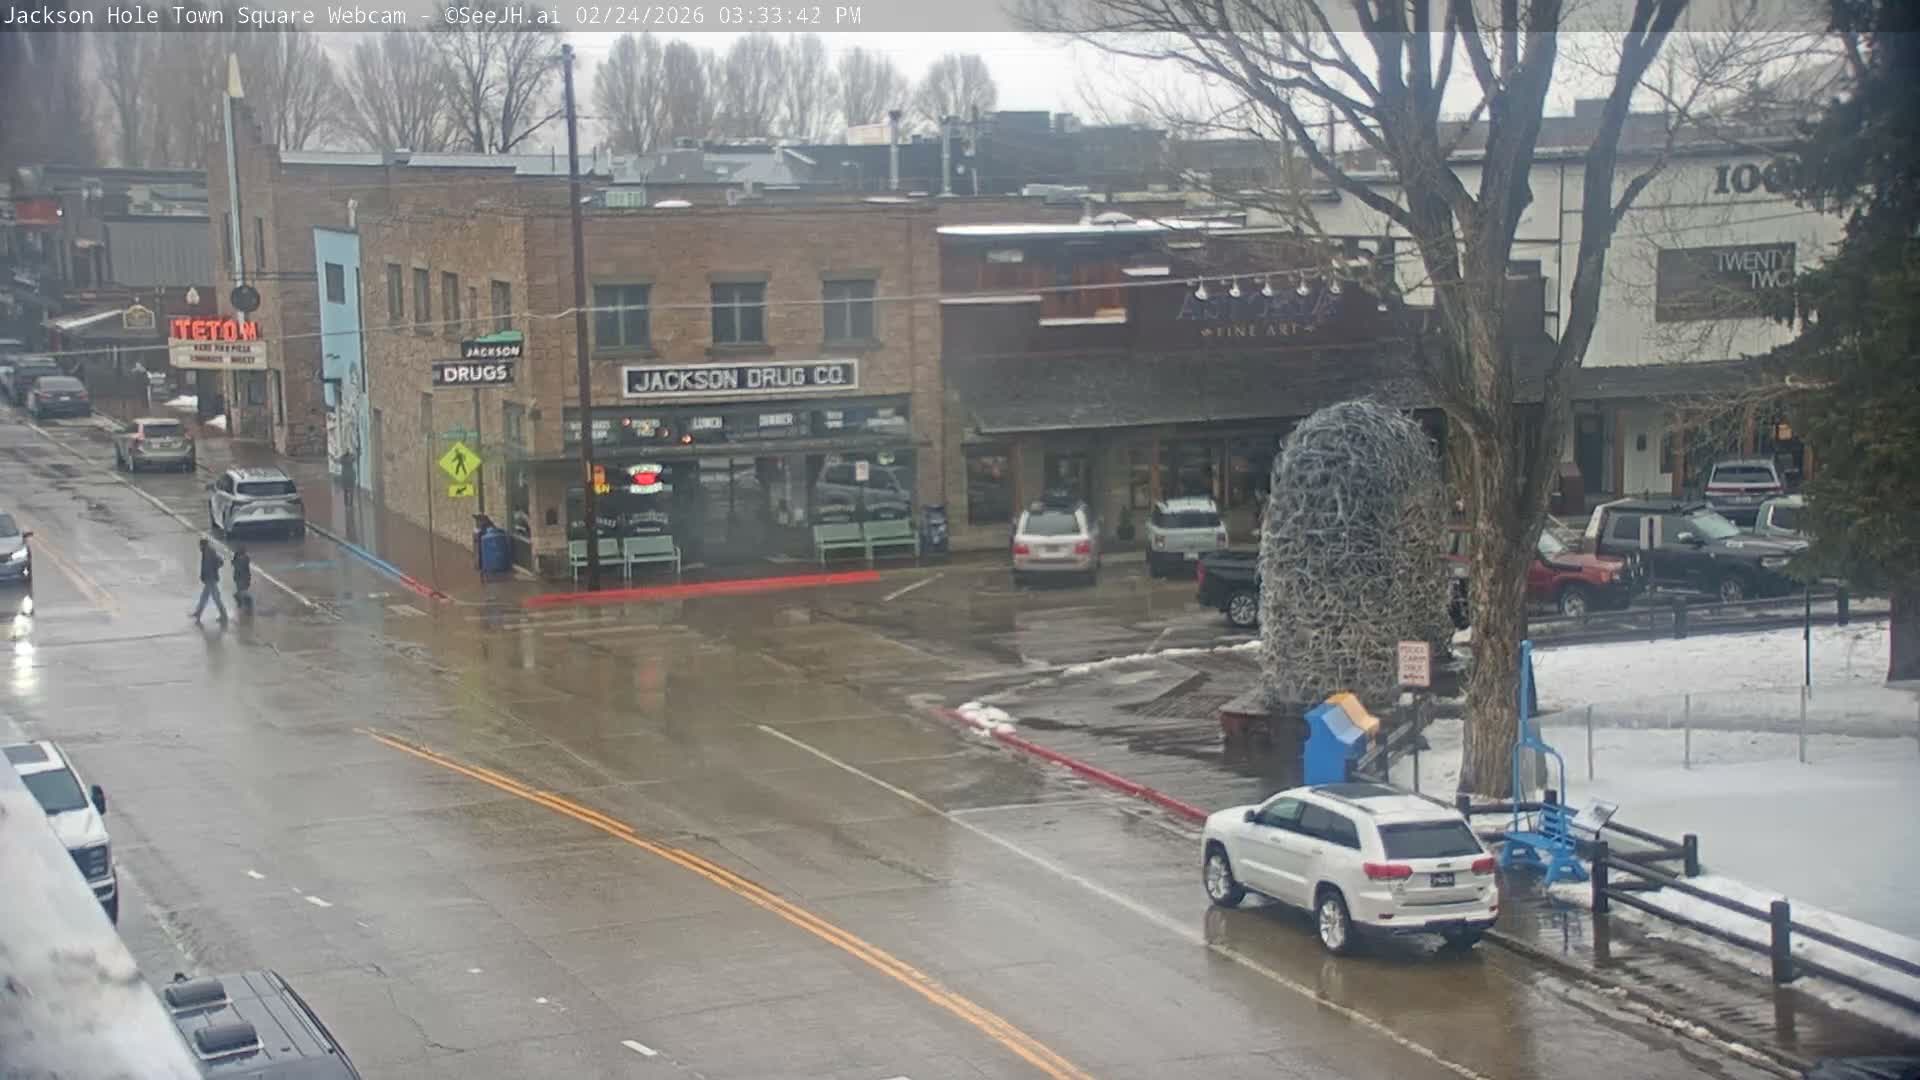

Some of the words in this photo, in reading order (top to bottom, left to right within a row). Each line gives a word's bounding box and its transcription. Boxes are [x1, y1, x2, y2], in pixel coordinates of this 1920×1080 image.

[1714, 248, 1792, 272] TWENTY
[1216, 323, 1256, 337] FINE
[1265, 320, 1298, 336] ART
[465, 346, 520, 358] JACKSON
[443, 364, 507, 382] DRUGS
[634, 369, 738, 392] JACKSON
[746, 366, 805, 388] DRUG
